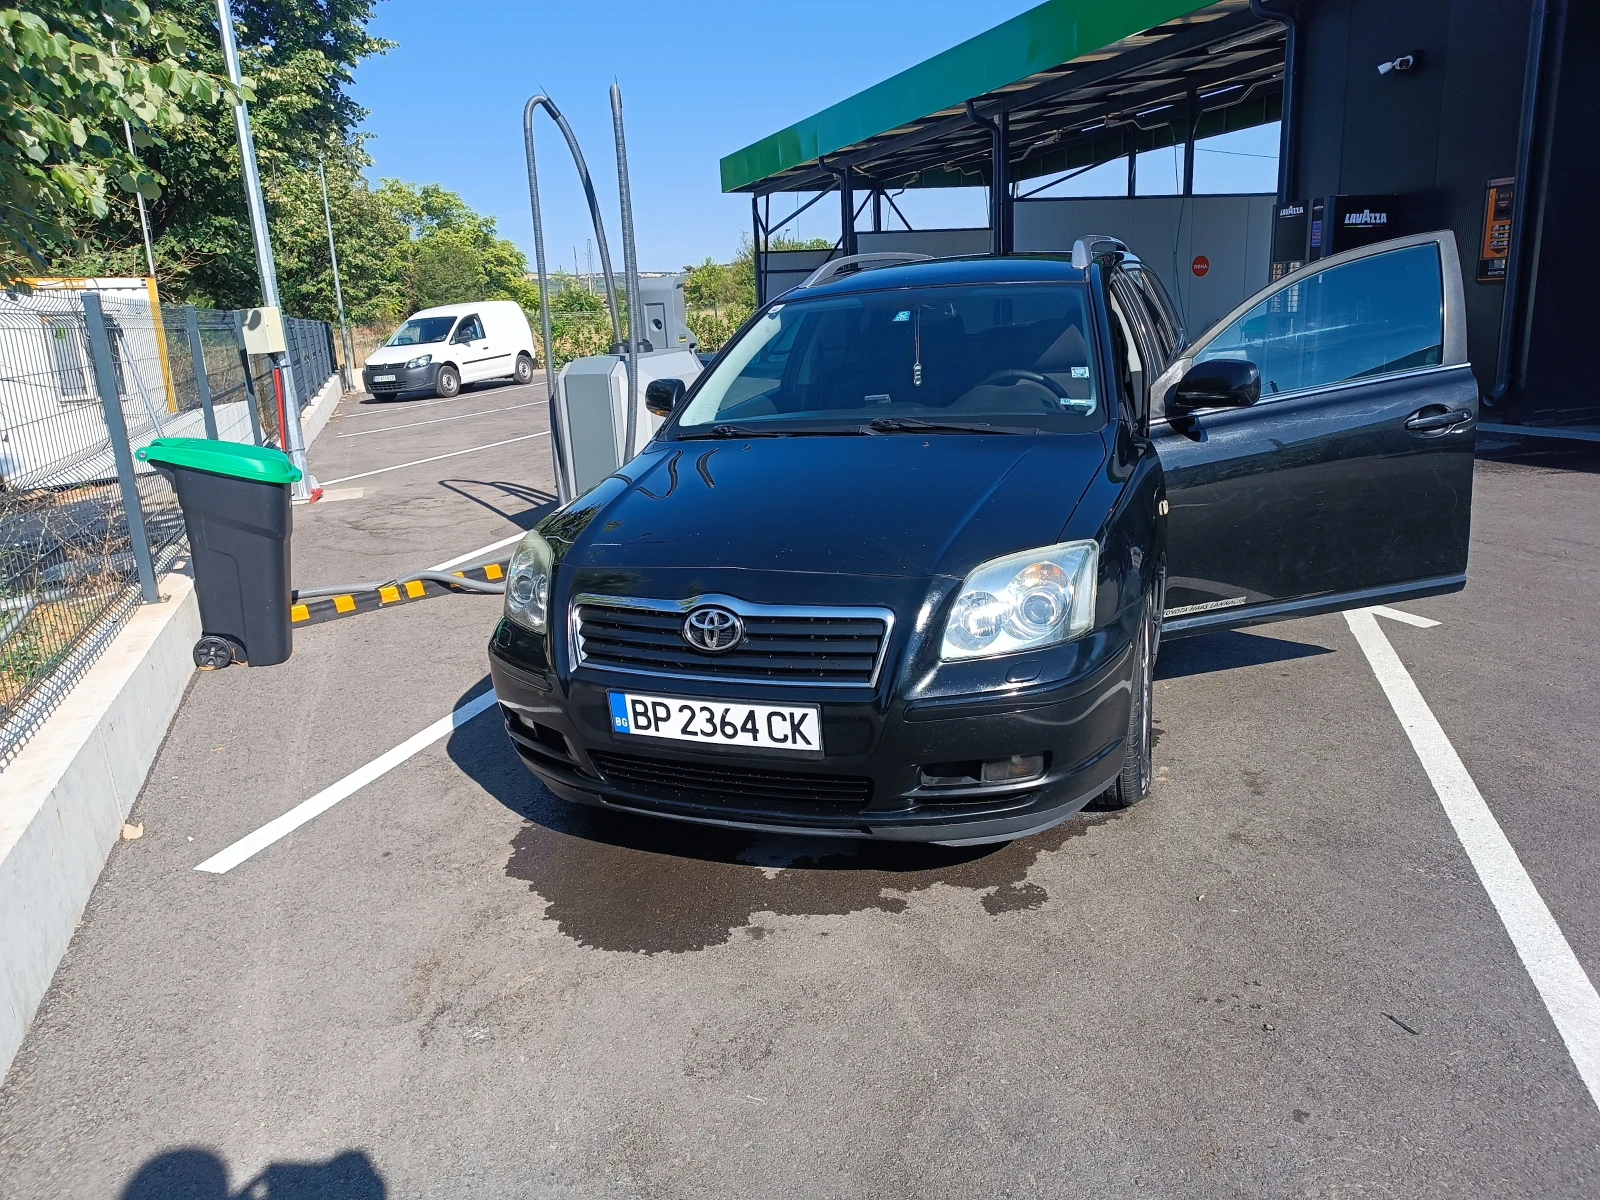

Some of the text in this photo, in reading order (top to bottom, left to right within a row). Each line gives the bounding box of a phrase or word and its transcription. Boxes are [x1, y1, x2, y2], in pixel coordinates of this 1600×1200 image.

[1280, 206, 1304, 216] LAVAZZA
[1344, 209, 1387, 224] LAVAZZA
[615, 716, 628, 728] BG
[630, 698, 813, 746] BP 2364 CK
